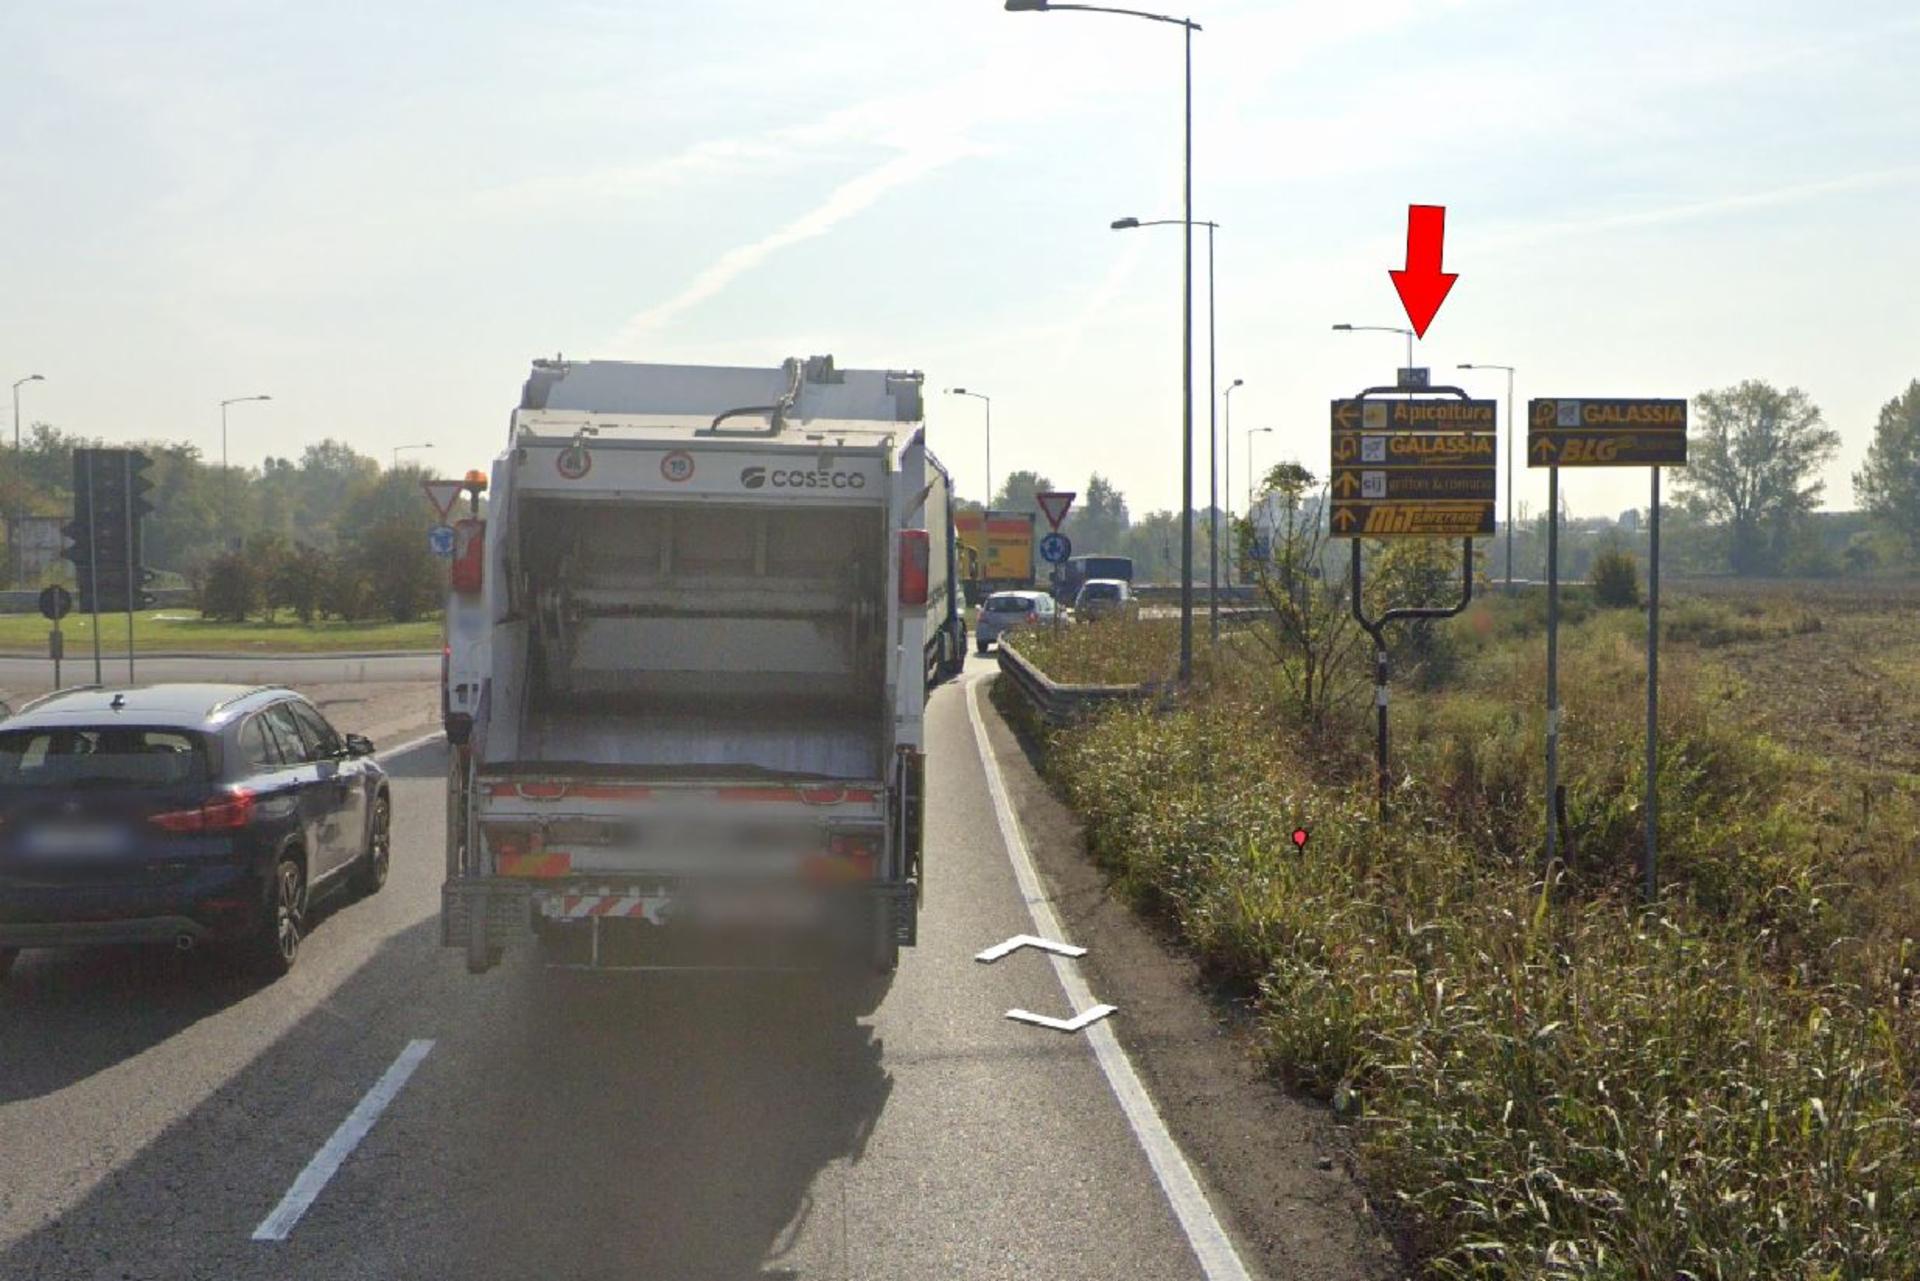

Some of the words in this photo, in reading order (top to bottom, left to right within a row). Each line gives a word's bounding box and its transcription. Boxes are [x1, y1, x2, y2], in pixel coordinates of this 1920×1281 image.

[1394, 402, 1492, 426] Apicoltura
[1584, 404, 1683, 422] GALASSIA
[1390, 436, 1491, 454] GALASSIA
[772, 470, 865, 488] COSECO
